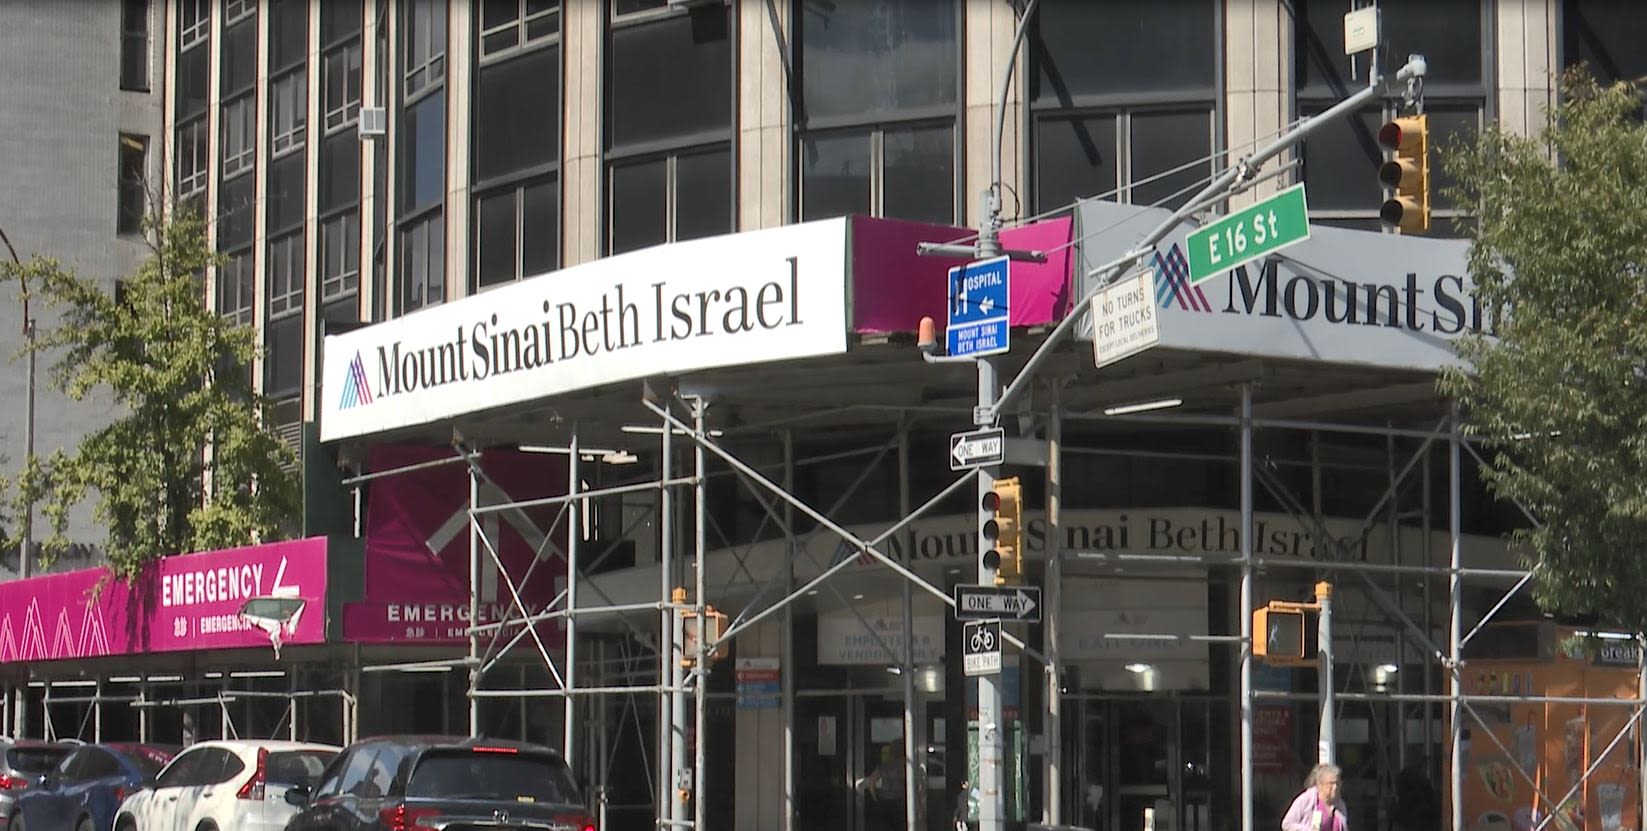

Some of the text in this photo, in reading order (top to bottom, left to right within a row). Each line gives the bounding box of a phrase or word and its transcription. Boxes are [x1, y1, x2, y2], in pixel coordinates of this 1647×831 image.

[1208, 209, 1278, 265] E 16 St
[1102, 287, 1145, 317] NO TURNS
[1221, 255, 1425, 333] Mount
[376, 255, 804, 399] Mount Sinai Beth Israel
[958, 323, 998, 341] MOUNT SINAI
[1098, 305, 1152, 340] FOR TRUCKS
[957, 336, 998, 354] BETH ISRAEL
[957, 439, 999, 458] ONE WAY
[885, 522, 979, 563] Mou
[1026, 514, 1129, 552] Snai
[1147, 516, 1241, 552] Beth
[162, 562, 264, 608] EMERGENCY
[387, 602, 538, 622] EMERGENCY
[968, 596, 1028, 611] ONE WAY
[200, 613, 253, 635] EMERGENCIA
[447, 626, 520, 639] EMEGENCIA
[966, 655, 998, 671] BIKE PATH
